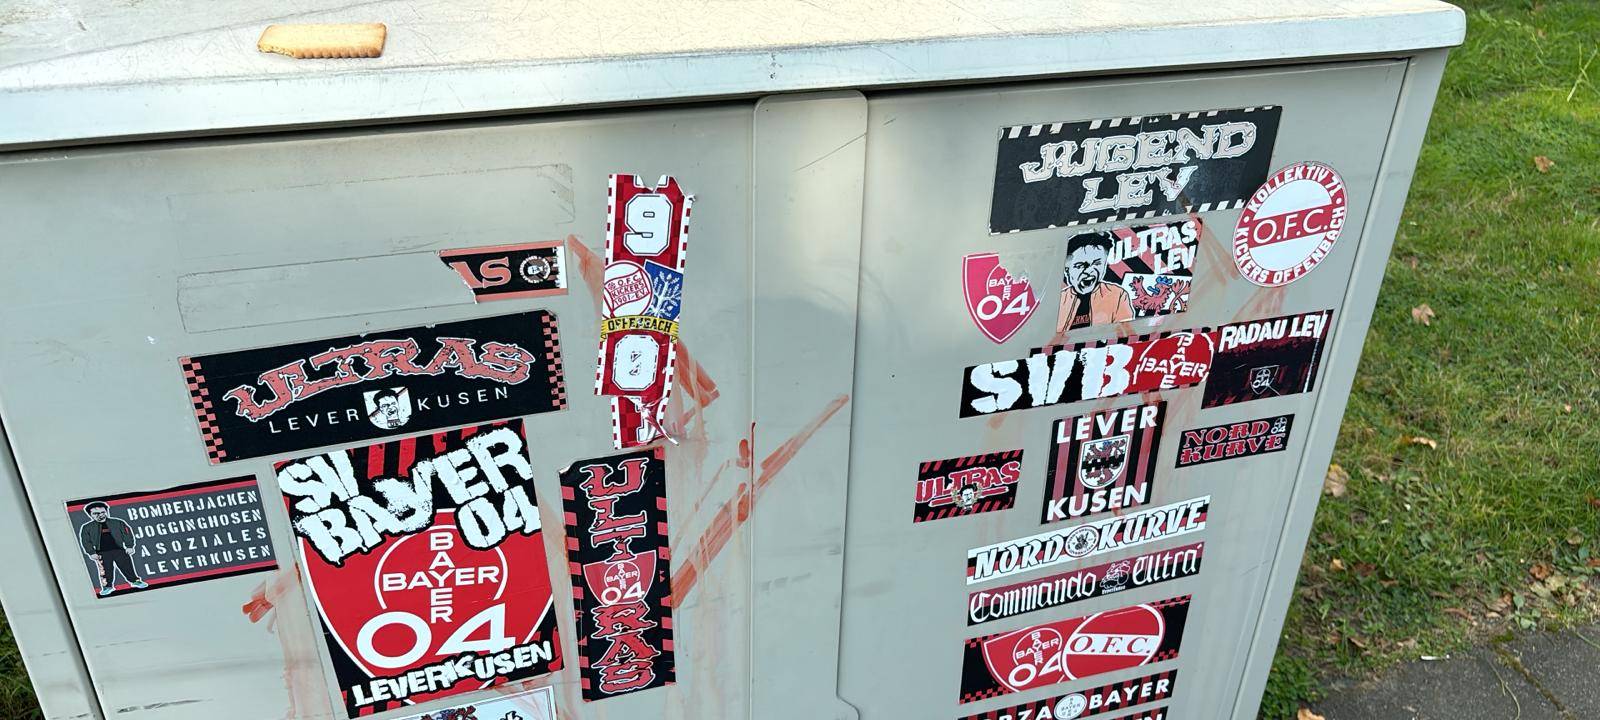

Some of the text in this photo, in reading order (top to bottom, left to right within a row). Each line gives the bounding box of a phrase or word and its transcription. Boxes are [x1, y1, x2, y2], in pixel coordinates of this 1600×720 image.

[1019, 121, 1256, 183] JUGEND
[1078, 166, 1198, 213] LEV
[1248, 165, 1342, 212] KOLLEKTIV 71
[1108, 220, 1197, 265] ULTRAS
[1236, 206, 1344, 284] KICKERS OFFENBACH
[1253, 209, 1328, 243] O.F.C.
[1153, 244, 1197, 274] LEV
[977, 291, 1030, 320] 04
[1218, 311, 1328, 352] RADAU LEV
[222, 337, 535, 422] ULTRAS
[970, 344, 1133, 413] SVB
[1140, 356, 1209, 378] BAYER
[418, 386, 509, 412] KUSEN
[269, 408, 360, 434] LEVER
[1056, 405, 1157, 444] LEVER
[1185, 420, 1270, 448] NORD
[1180, 433, 1286, 464] KURVE
[277, 450, 360, 513] SV
[294, 427, 532, 565] BAYER
[915, 461, 1020, 503] ULTRAS
[127, 490, 258, 521] BOMBERJACKEN
[457, 485, 541, 548] 04
[1047, 483, 1148, 521] KUSEN
[135, 509, 262, 539] JOGGINGHOSEN
[141, 527, 267, 557] ASOZIALES
[973, 533, 1067, 580] NORD
[1097, 499, 1210, 551] KURVE
[145, 544, 271, 575] LEVERKUSEN
[429, 532, 455, 623] BAYER
[383, 566, 500, 592] BAYER
[601, 581, 645, 604] 04
[970, 571, 1096, 623] Commando
[357, 602, 516, 669] 04
[1016, 639, 1060, 660] BAYER
[1070, 635, 1151, 654] O.F.C.
[352, 640, 552, 707] LEVERKUSEN
[1008, 650, 1061, 687] 04
[1089, 678, 1169, 710] BAYER
